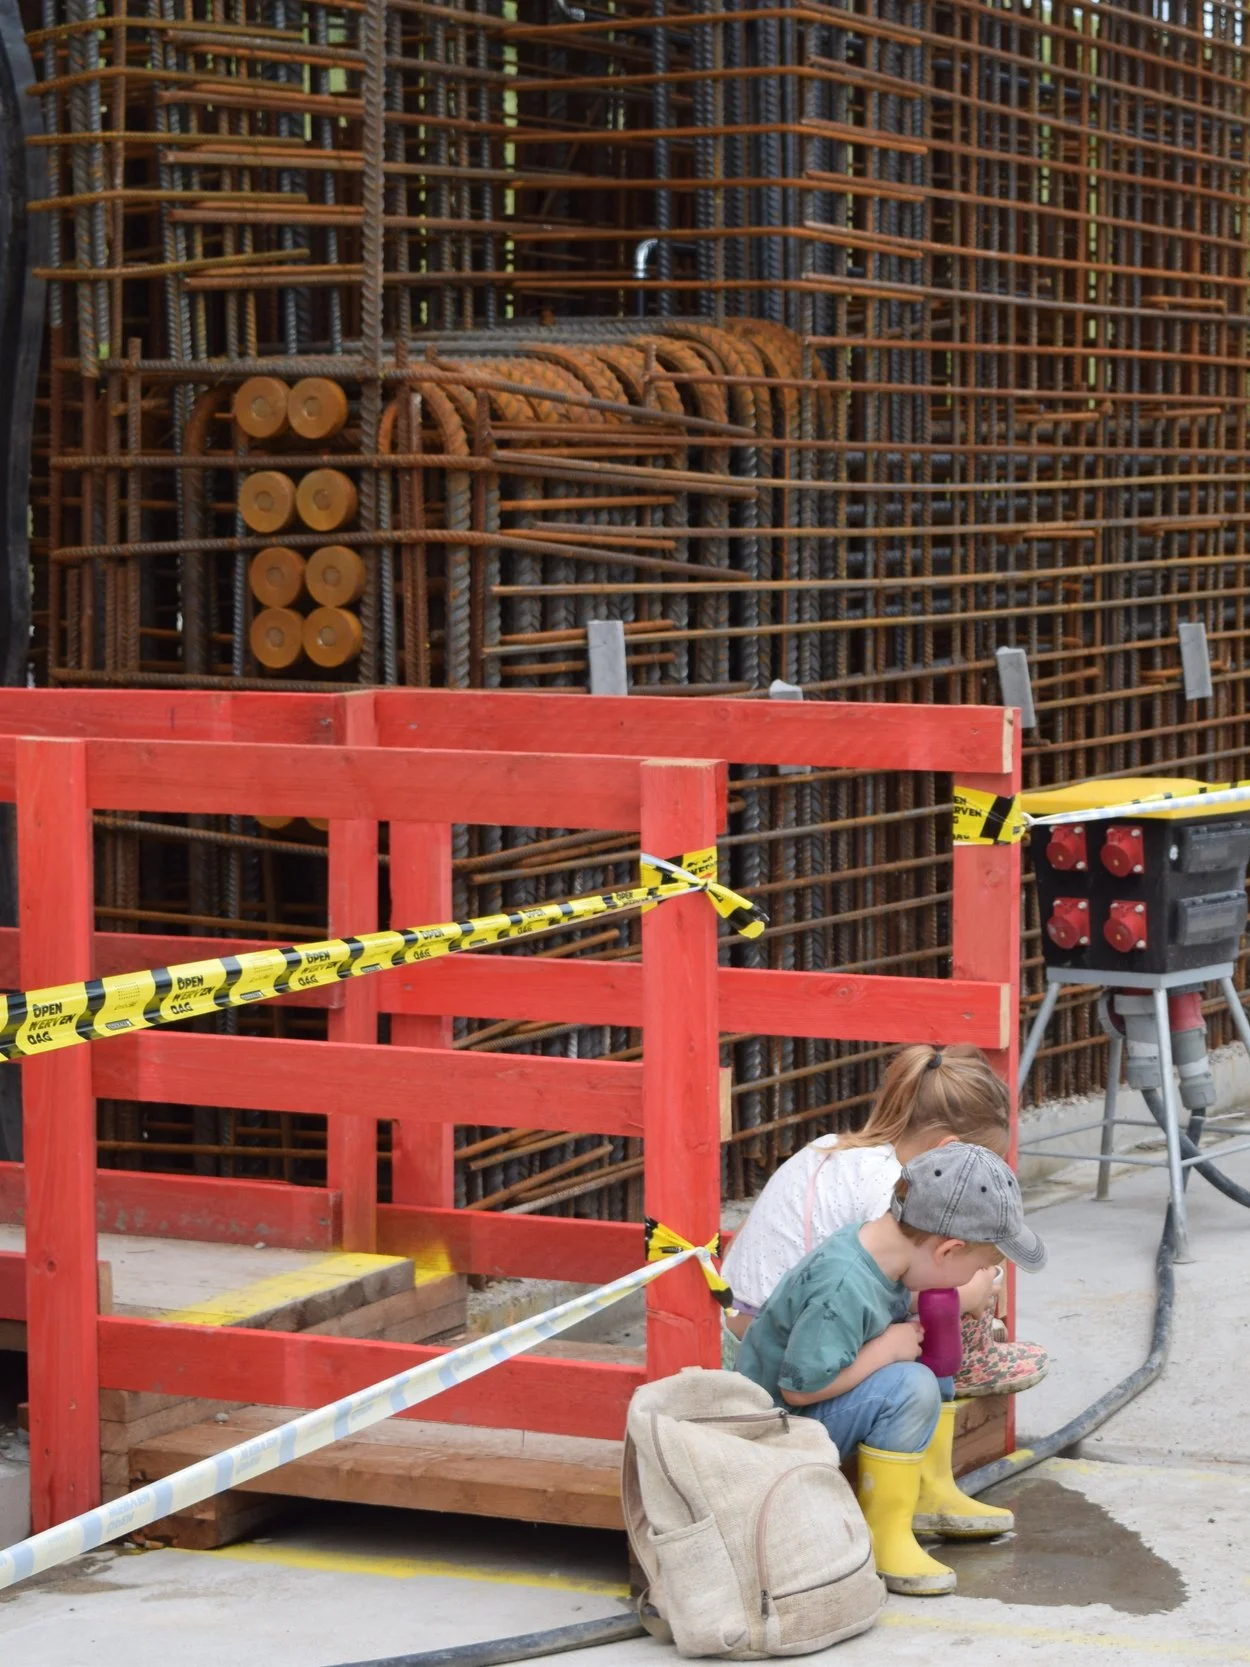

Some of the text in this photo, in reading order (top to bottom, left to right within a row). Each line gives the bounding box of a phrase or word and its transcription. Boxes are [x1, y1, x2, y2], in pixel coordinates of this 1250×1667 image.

[305, 950, 330, 964] OPEN
[177, 975, 204, 990] OPEN
[298, 975, 319, 986] DAG
[32, 1002, 62, 1018] OPEN
[170, 1002, 193, 1014] DAG
[29, 1013, 76, 1031] WERVEN
[27, 1031, 53, 1045] DAG
